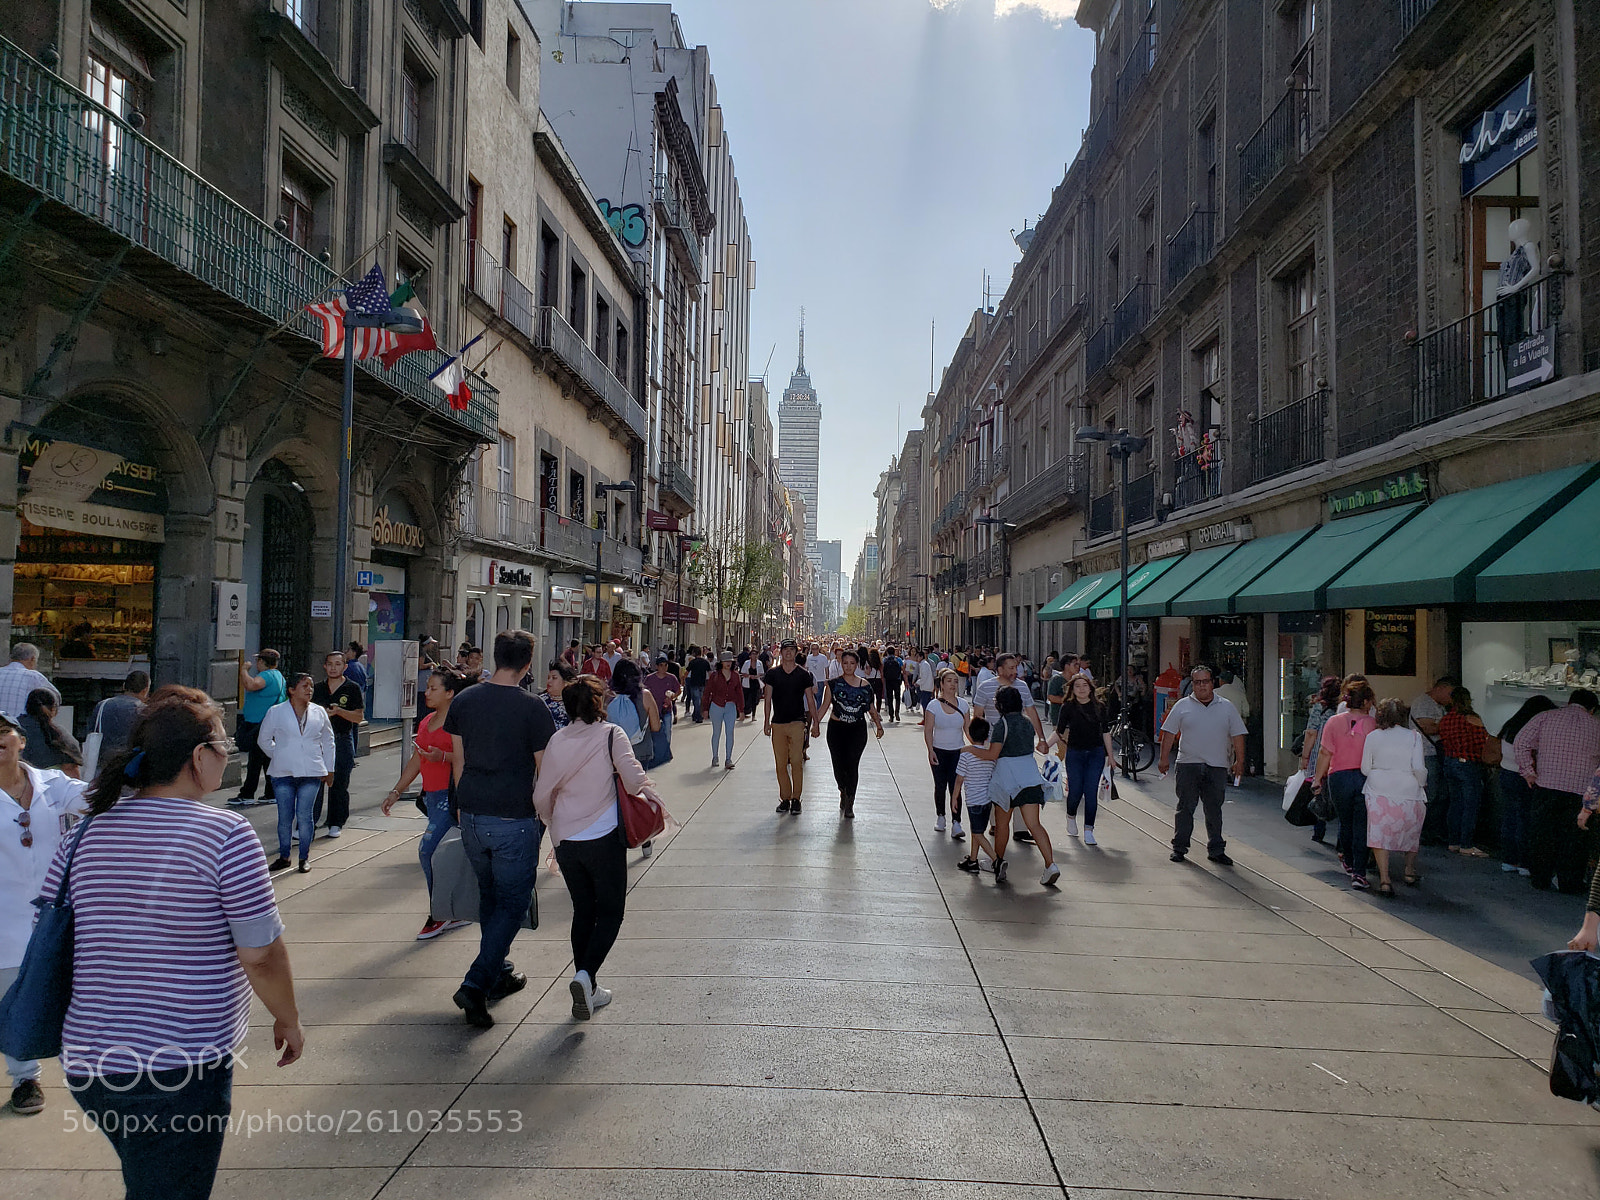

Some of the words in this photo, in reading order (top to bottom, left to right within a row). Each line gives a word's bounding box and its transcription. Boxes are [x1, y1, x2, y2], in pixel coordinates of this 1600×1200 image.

[1514, 127, 1538, 151] Jeans
[1519, 334, 1545, 354] Entrada
[1513, 359, 1519, 368] a
[1520, 355, 1527, 365] la
[1528, 345, 1550, 361] Vuelta
[98, 478, 115, 491] IS
[1327, 489, 1381, 514] Downtown
[1383, 473, 1426, 499] Salads
[359, 573, 370, 584] H
[632, 572, 648, 587] WC
[1366, 611, 1415, 622] Downtown
[1373, 622, 1408, 633] Salads
